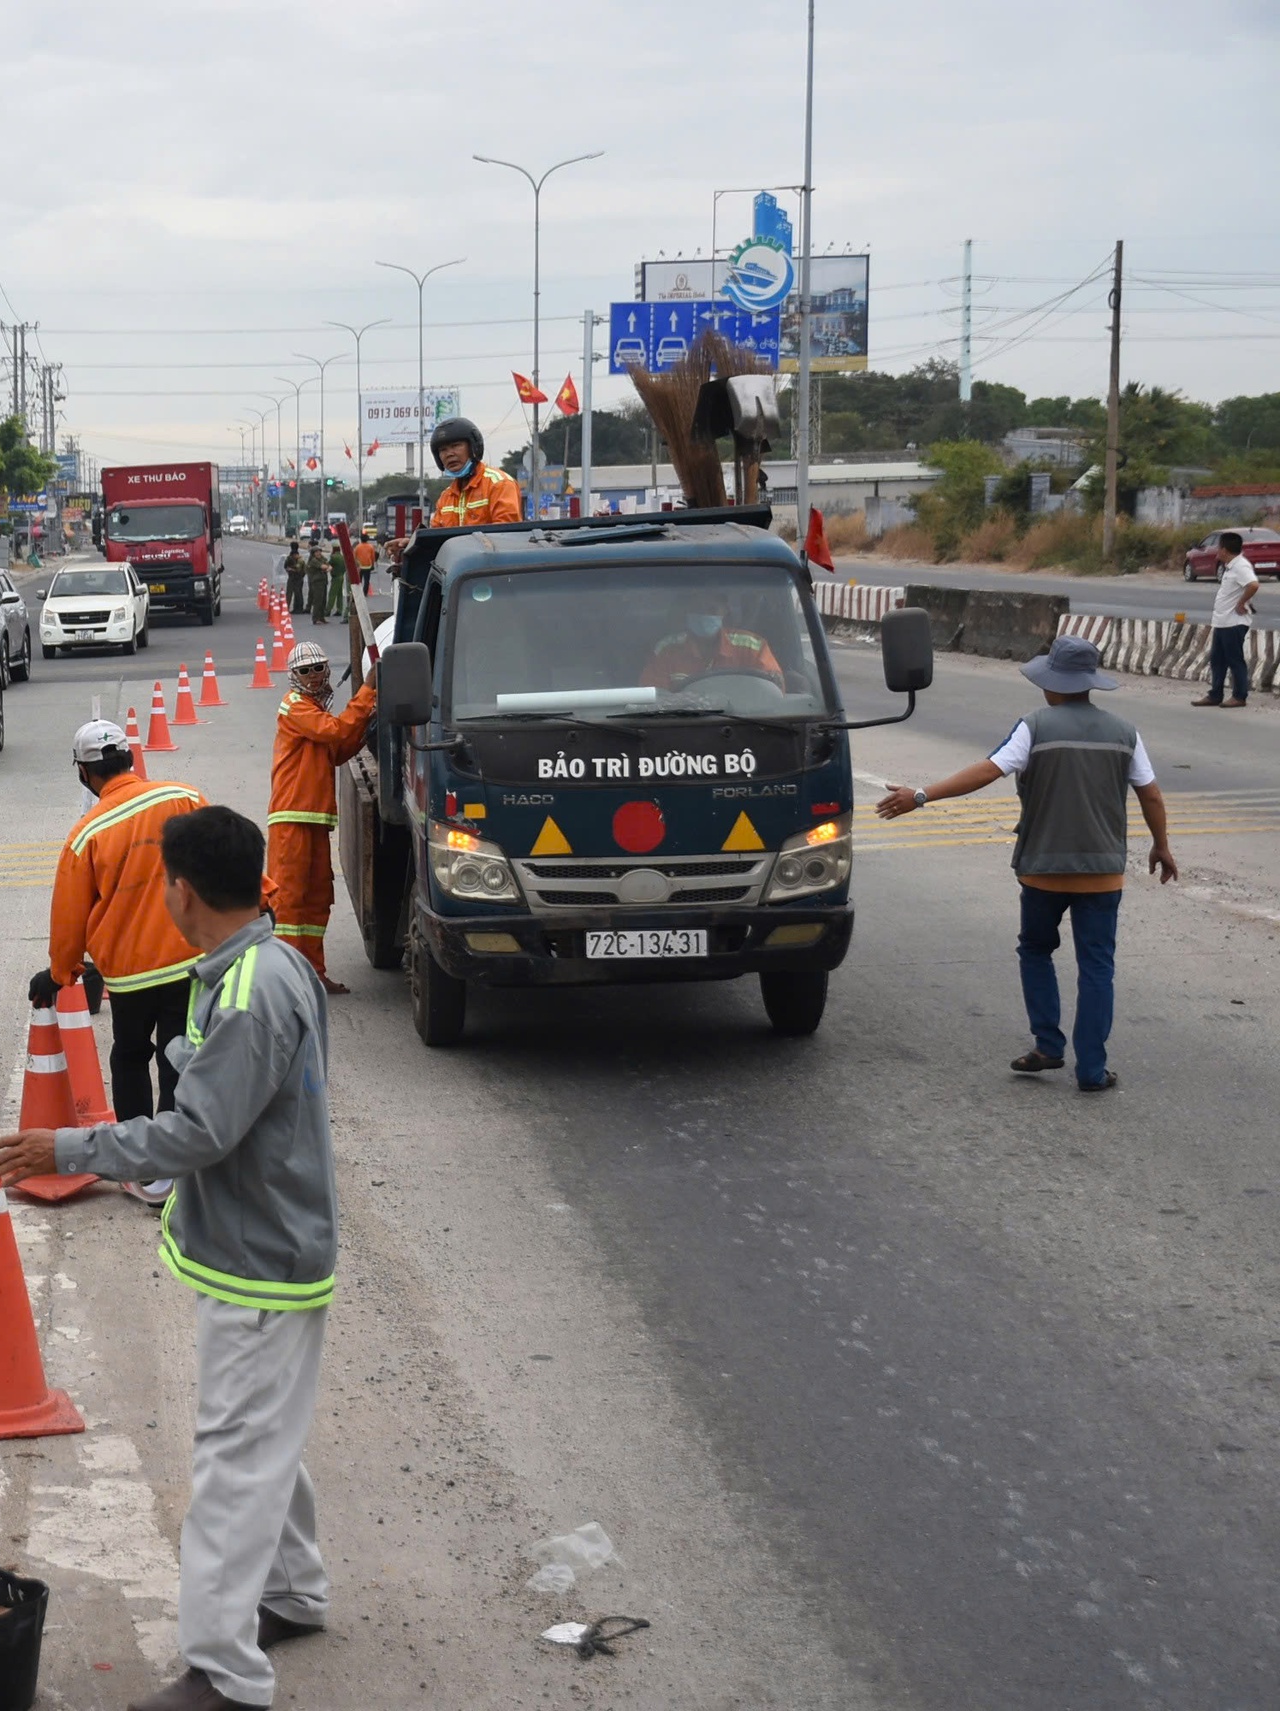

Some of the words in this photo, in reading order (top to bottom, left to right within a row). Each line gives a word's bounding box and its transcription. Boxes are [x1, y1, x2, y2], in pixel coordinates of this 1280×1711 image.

[368, 407, 391, 419] 0913
[393, 406, 411, 418] 069
[128, 474, 141, 484] XE
[538, 750, 585, 779] BẢO
[592, 752, 630, 778] TRÌ
[638, 749, 718, 777] ĐƯỜNG
[724, 748, 756, 780] BỘ
[712, 784, 798, 799] FORLAND
[503, 793, 554, 806] HACO
[590, 931, 702, 958] 72C-134.31
